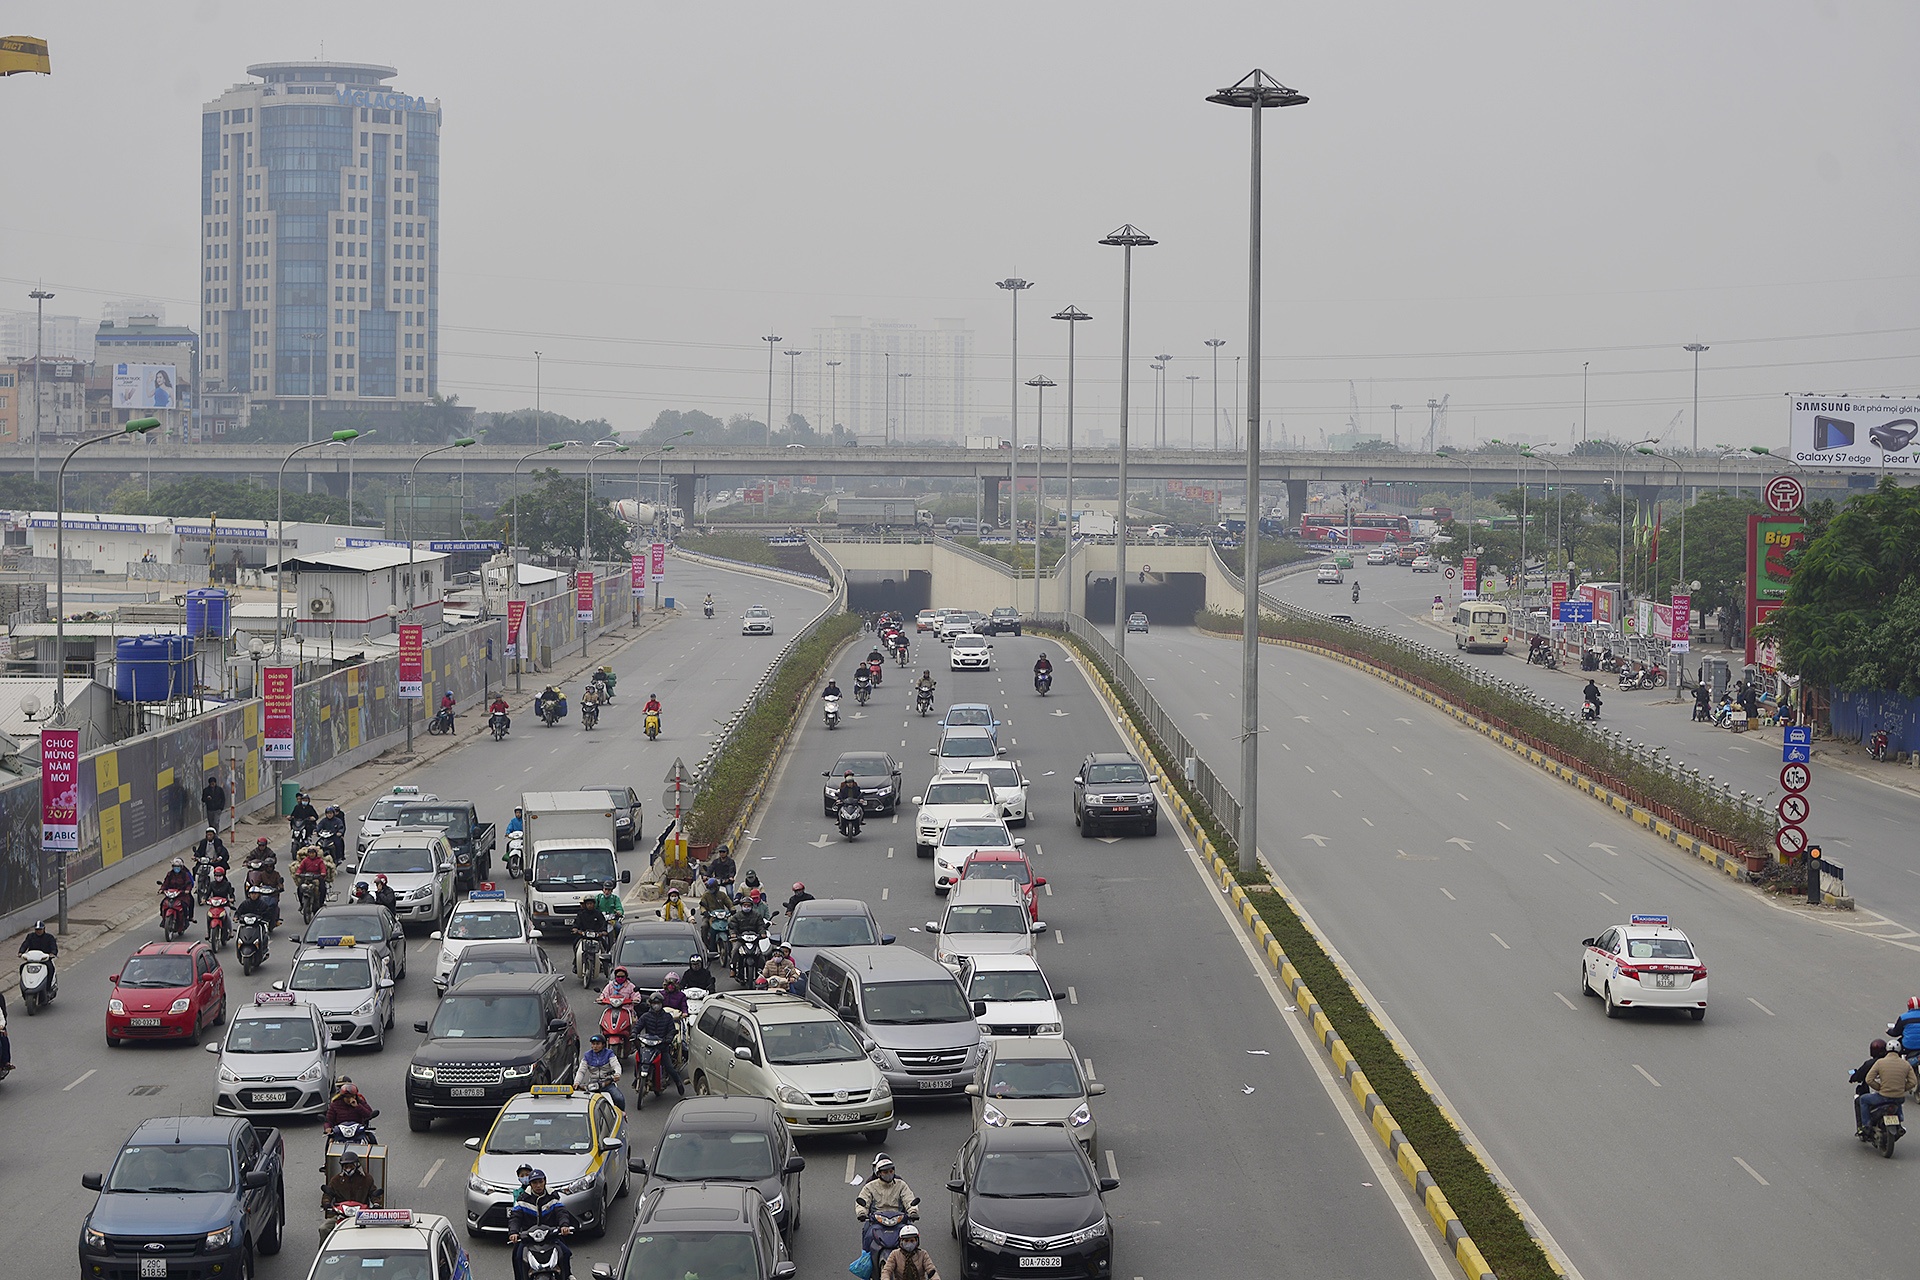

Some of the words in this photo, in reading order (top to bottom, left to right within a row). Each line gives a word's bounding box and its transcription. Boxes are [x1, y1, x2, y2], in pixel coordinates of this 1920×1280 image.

[2, 42, 23, 50] MCT
[336, 89, 427, 112] VIGLACERA
[1796, 402, 1850, 412] SAMSUNG
[1866, 404, 1881, 413] phá
[1883, 405, 1898, 414] mọi
[1898, 405, 1912, 414] giới
[1796, 452, 1834, 464] Galaxy
[1835, 454, 1847, 462] S7
[1848, 456, 1871, 464] edge
[1883, 454, 1909, 463] Gear
[1764, 530, 1791, 548] Big
[46, 738, 74, 747] CHÚC
[44, 749, 75, 759] MỪNG
[49, 761, 71, 770] NĂM
[50, 772, 70, 782] MỚI
[1786, 771, 1805, 786] 4,75m
[48, 810, 74, 818] 2017
[54, 832, 76, 840] ABIC
[388, 1211, 399, 1219] NOI
